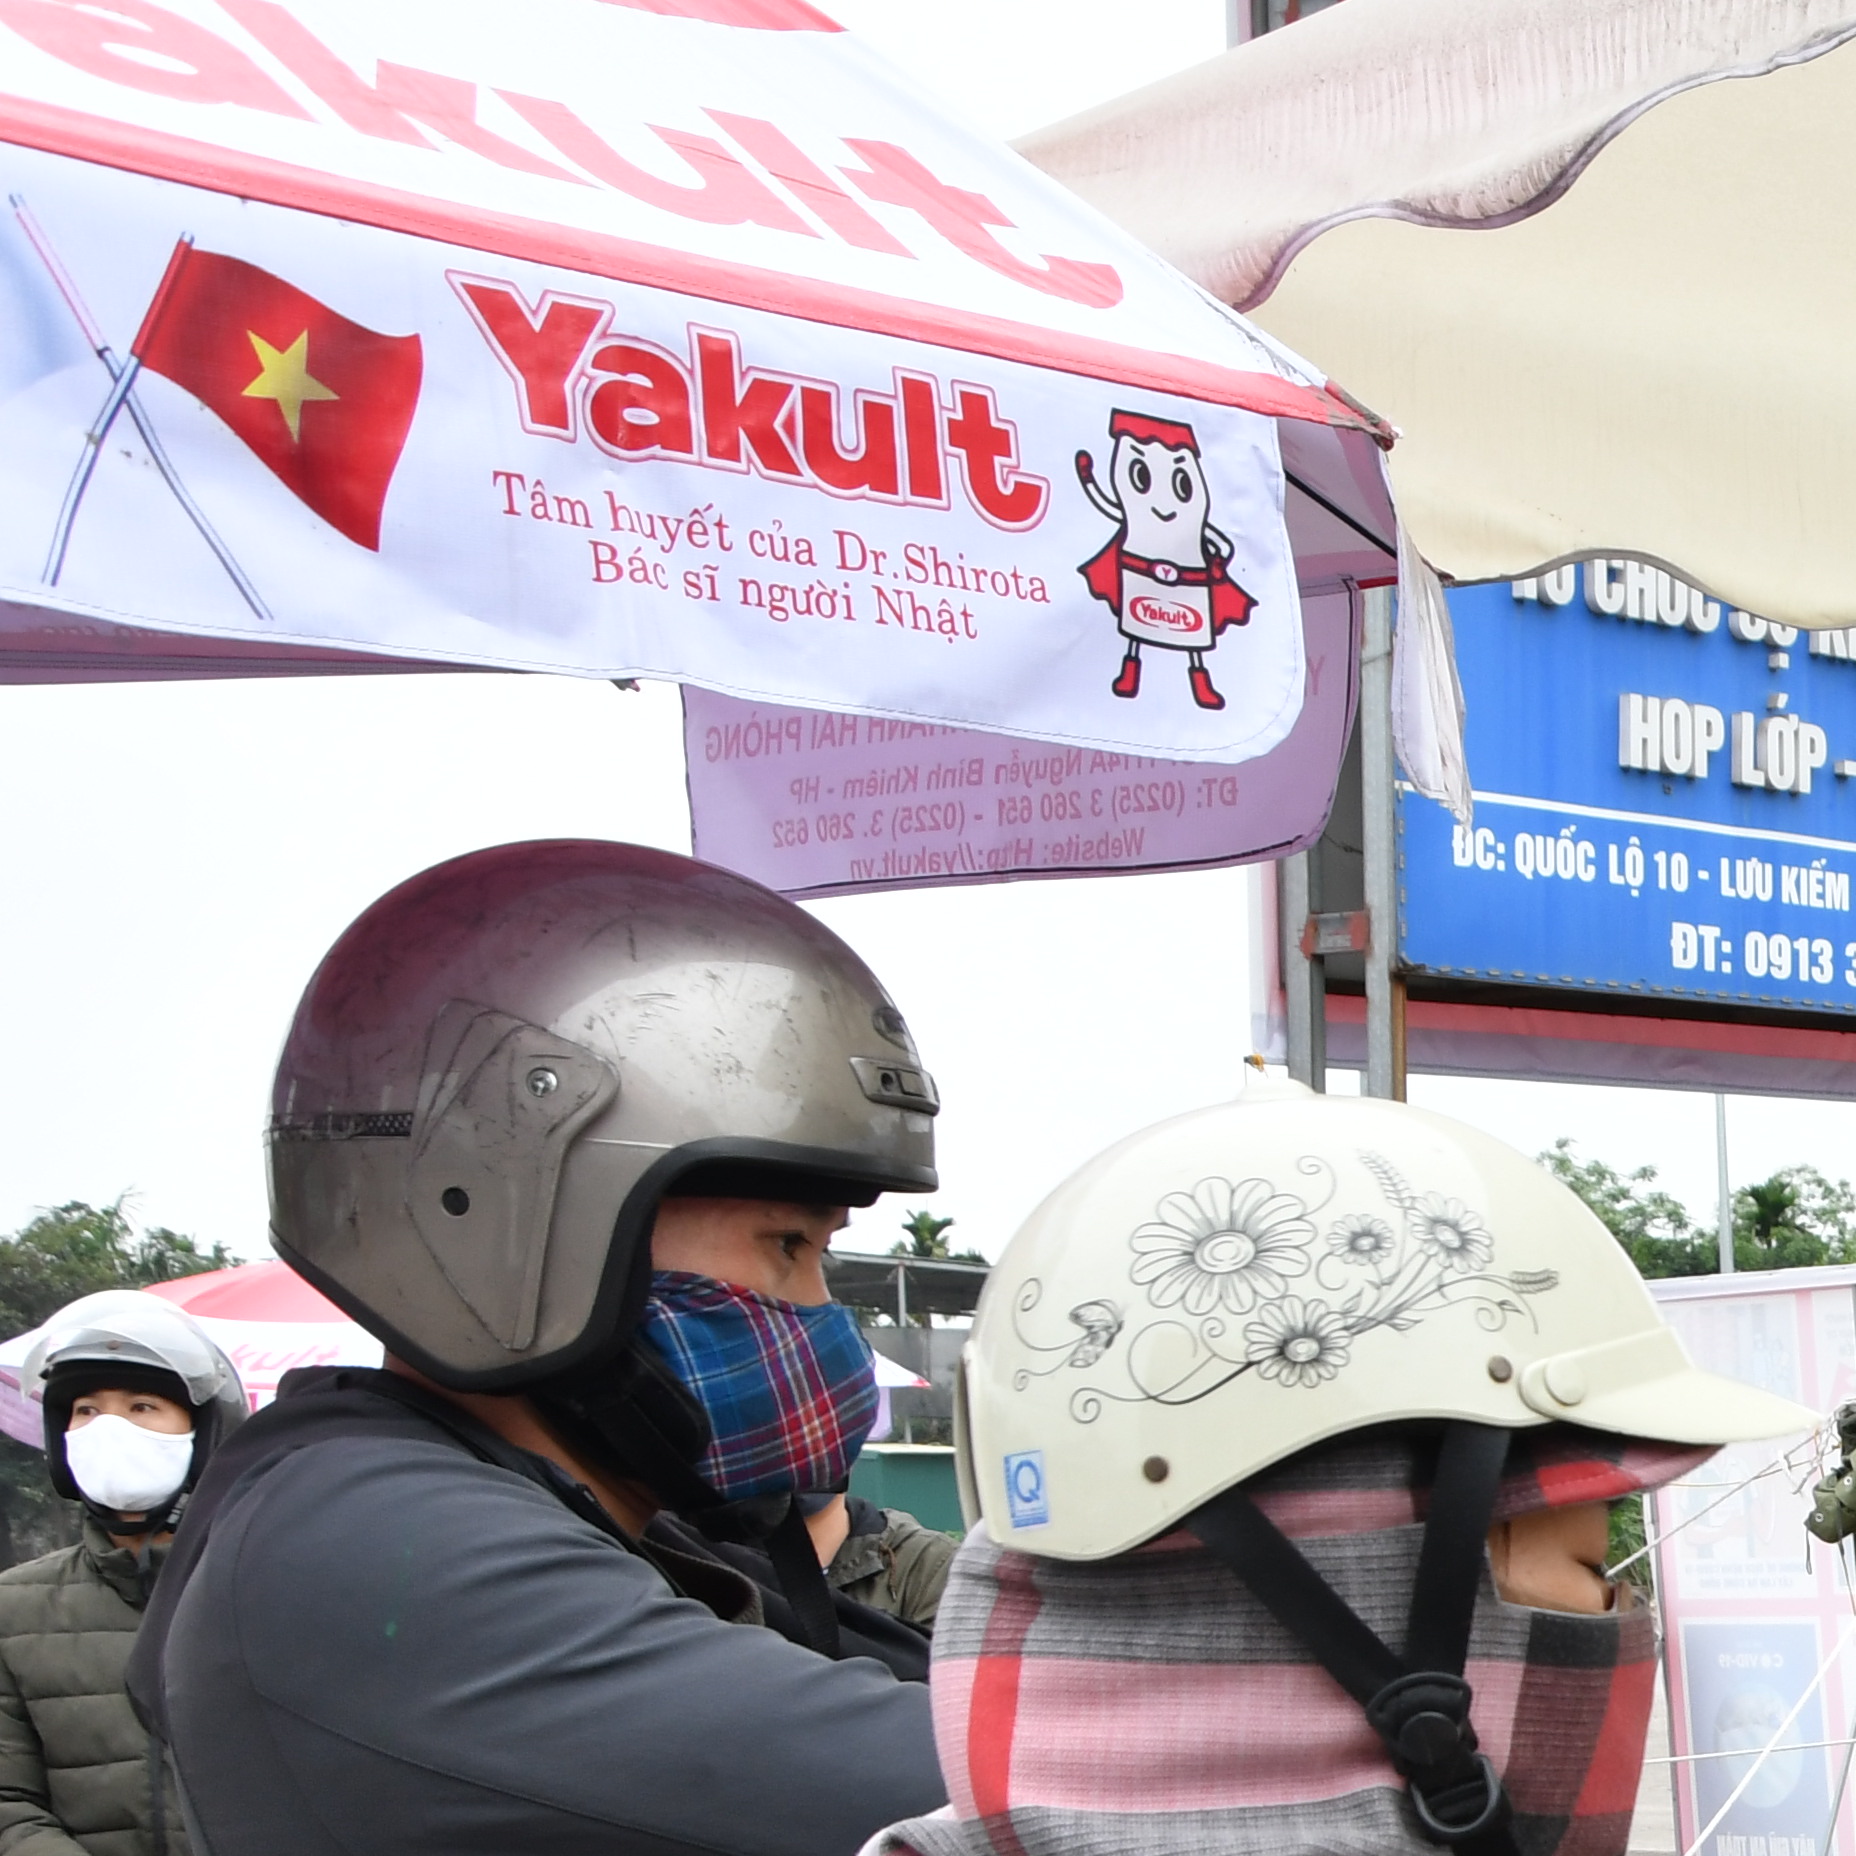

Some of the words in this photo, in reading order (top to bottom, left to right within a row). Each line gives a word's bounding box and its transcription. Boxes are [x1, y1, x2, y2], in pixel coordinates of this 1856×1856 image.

[453, 274, 1047, 531] Yakult
[492, 469, 594, 529] Tâm
[603, 502, 733, 553] huyết
[749, 519, 817, 567] của
[833, 529, 1050, 604] Dr.Shirota
[588, 539, 669, 590] Bác
[683, 563, 721, 602] sĩ
[737, 577, 857, 622] người
[871, 583, 977, 643] Nhật
[1141, 602, 1192, 627] Yakult
[1731, 692, 1828, 795] LỚP
[1452, 824, 1506, 871] ĐC:
[1514, 824, 1596, 882] QUỐC
[1608, 836, 1646, 898] LỘ
[1653, 850, 1689, 892] 10
[1720, 856, 1774, 902] LƯU
[1780, 858, 1850, 912] KIẾM
[1670, 921, 1732, 974] ĐT:
[1744, 931, 1834, 984] 0913
[1014, 1460, 1040, 1503] Q
